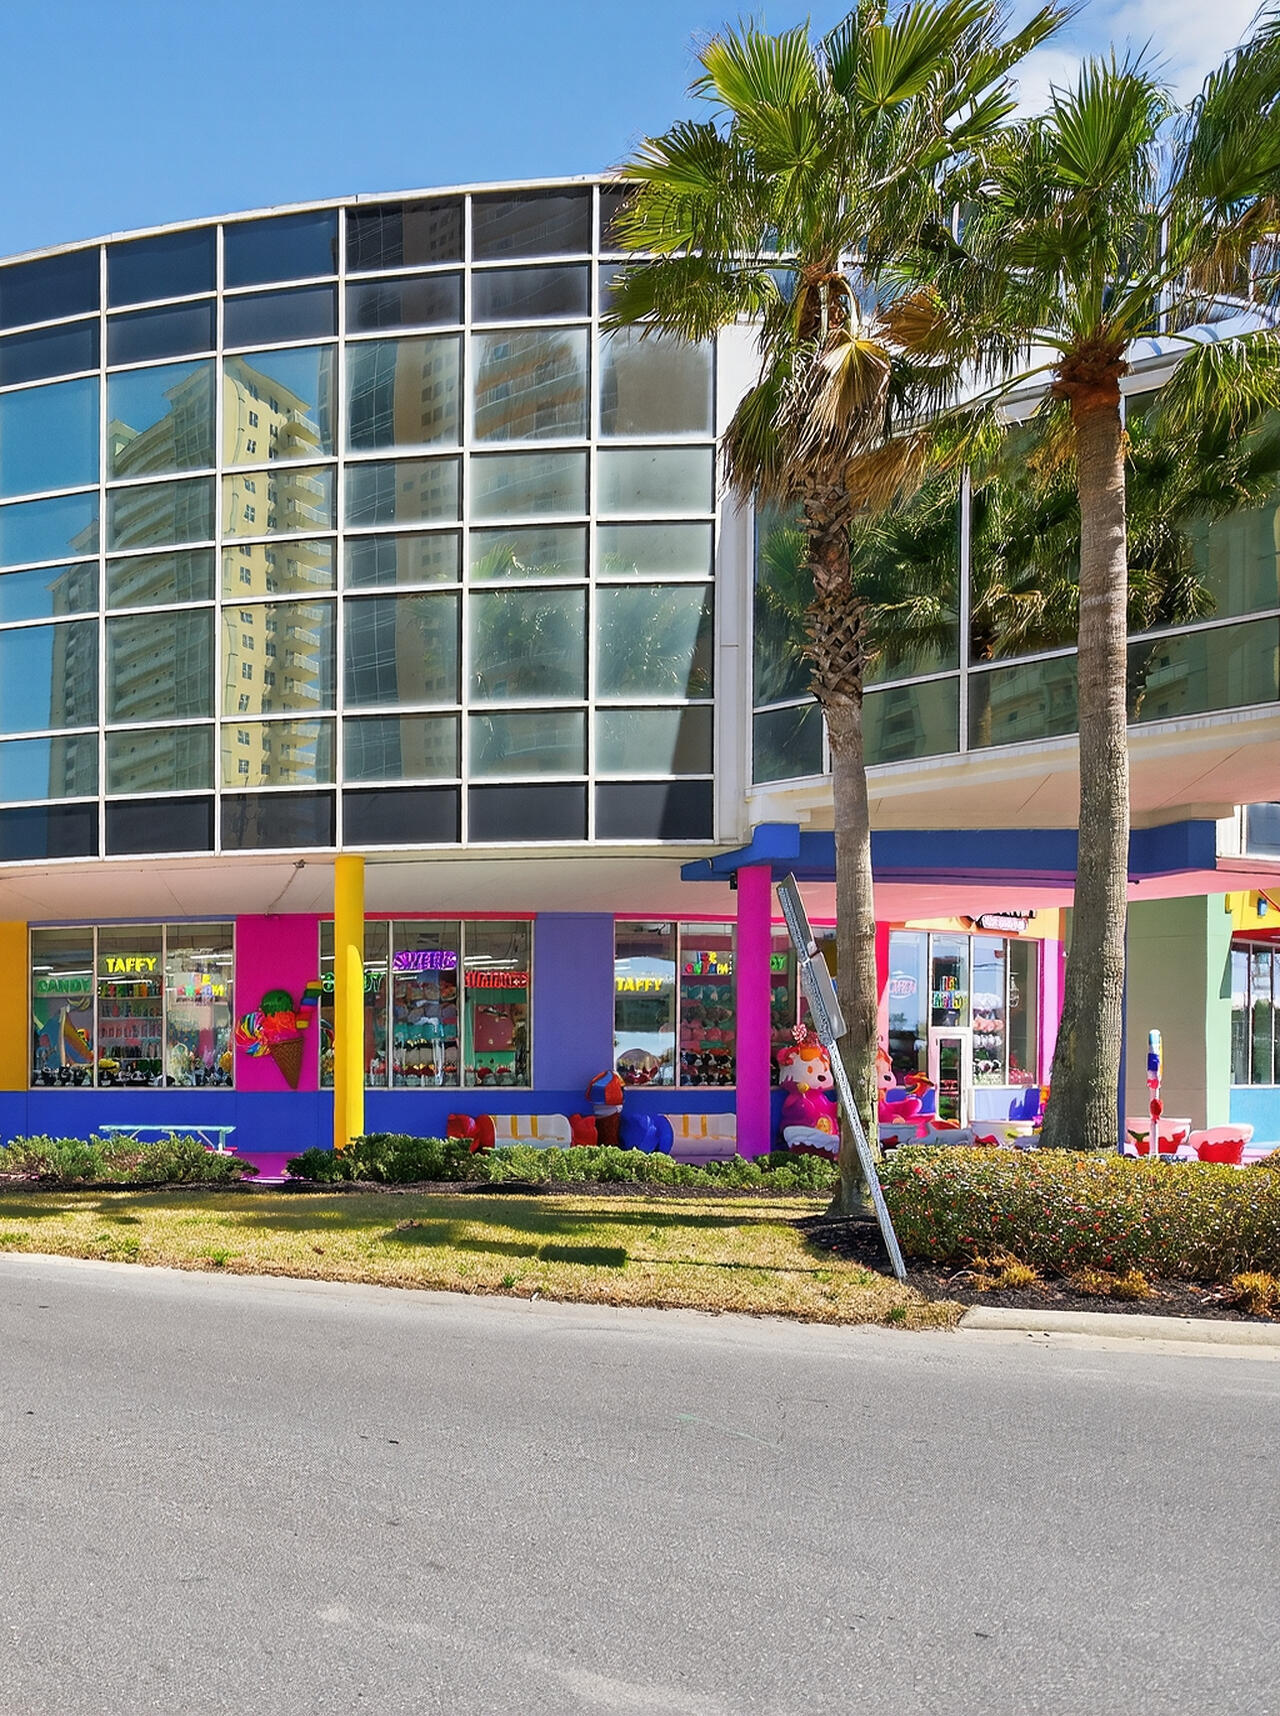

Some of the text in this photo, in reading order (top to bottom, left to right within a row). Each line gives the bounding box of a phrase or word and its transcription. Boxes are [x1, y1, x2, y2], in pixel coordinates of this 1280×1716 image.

[105, 956, 159, 974] TAFFY
[35, 978, 93, 994] CANDY
[615, 976, 663, 993] TAFFY
